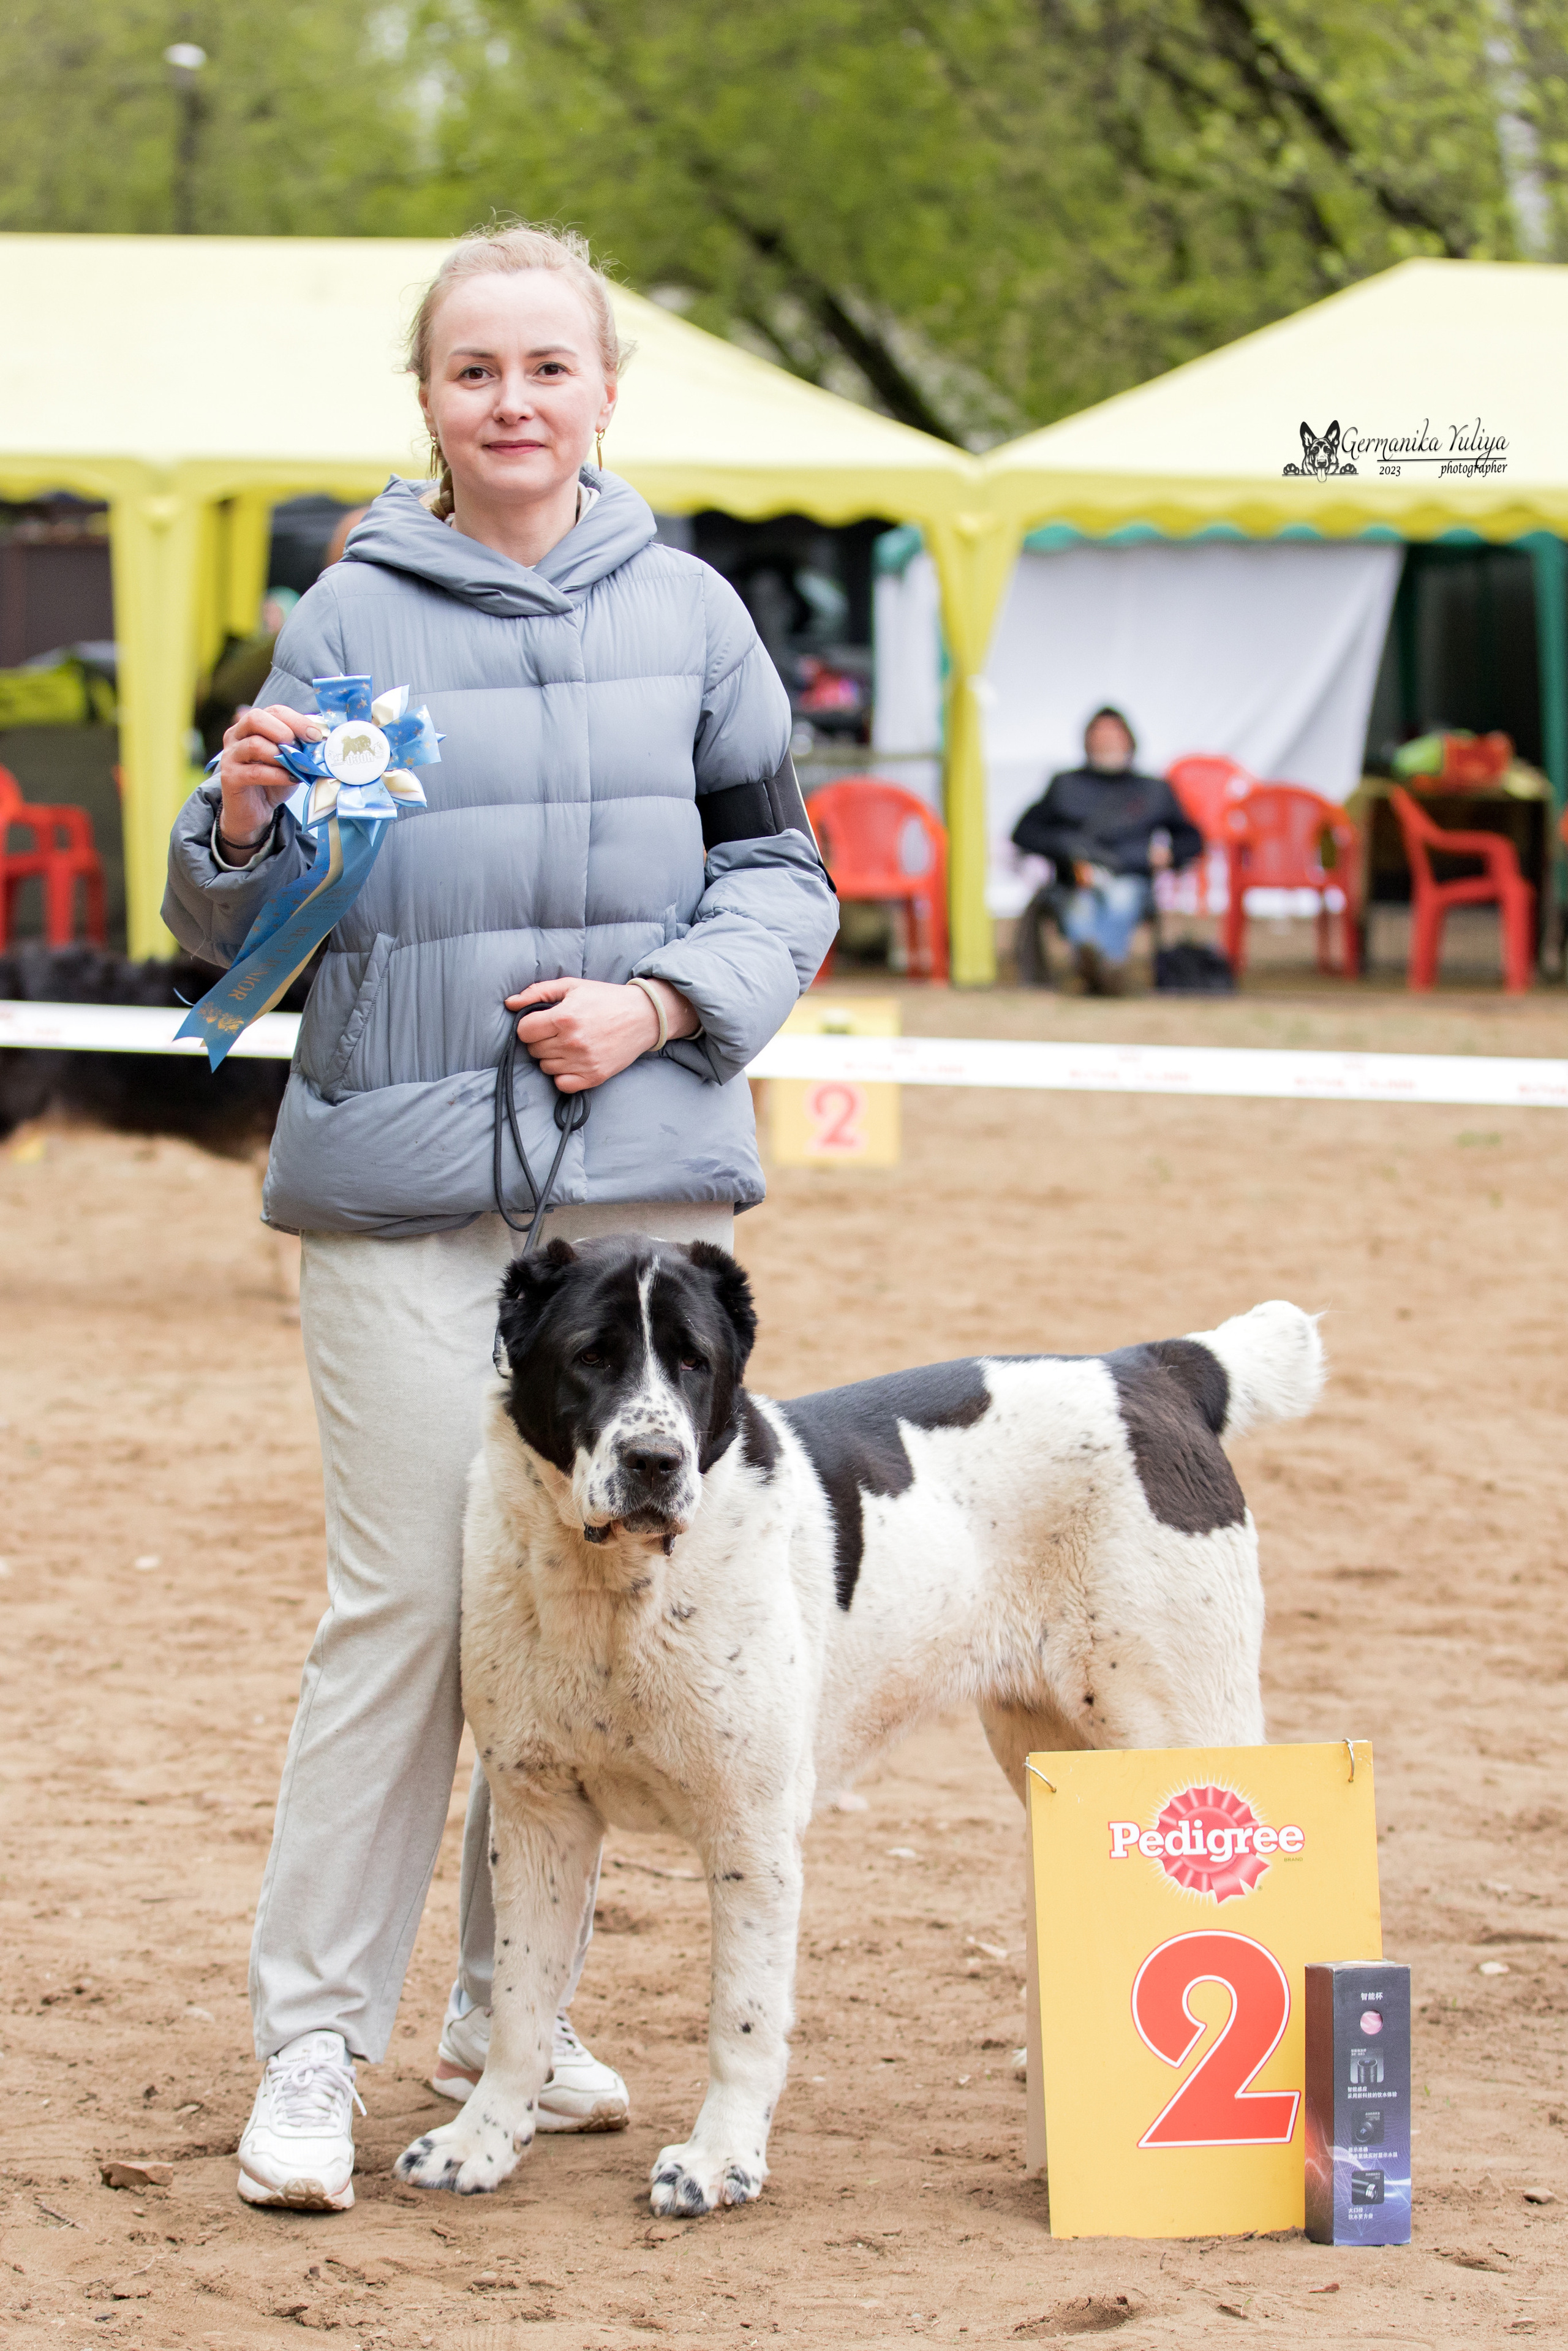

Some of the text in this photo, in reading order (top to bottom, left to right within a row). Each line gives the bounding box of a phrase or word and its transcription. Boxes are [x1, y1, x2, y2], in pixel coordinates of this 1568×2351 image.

[227, 956, 282, 1001] JUNIOR
[810, 1081, 861, 1152] 2
[1108, 1819, 1305, 1862] Pedigree
[1360, 1992, 1383, 2001] 智能杯
[1131, 1930, 1301, 2148] 2
